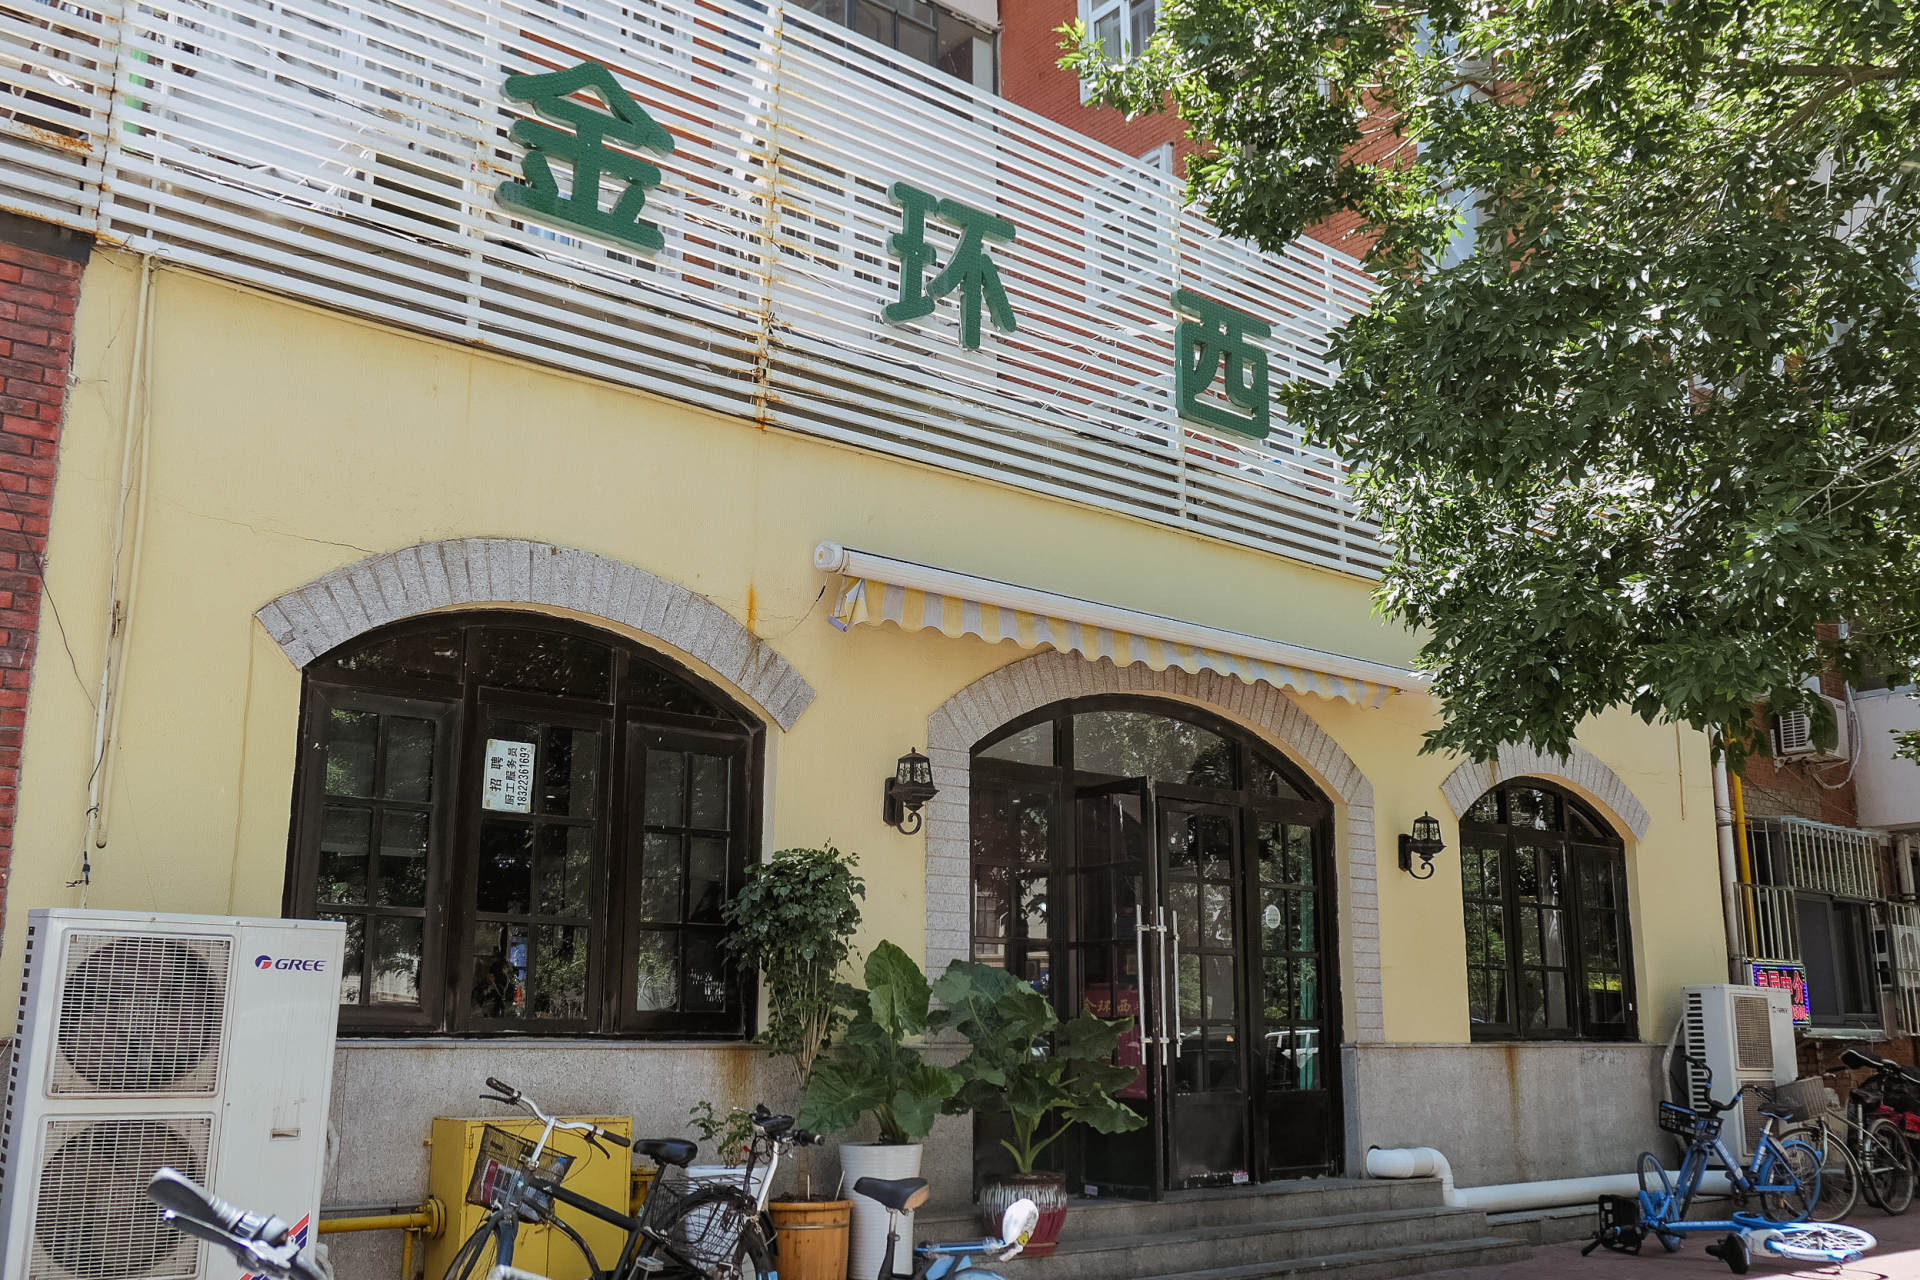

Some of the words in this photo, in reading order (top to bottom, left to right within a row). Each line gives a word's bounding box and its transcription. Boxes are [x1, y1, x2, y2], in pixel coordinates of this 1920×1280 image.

[494, 61, 1272, 439] 金环西
[489, 757, 503, 792] 招聘
[505, 748, 517, 806] 厨工服务员
[275, 958, 327, 971] GREE
